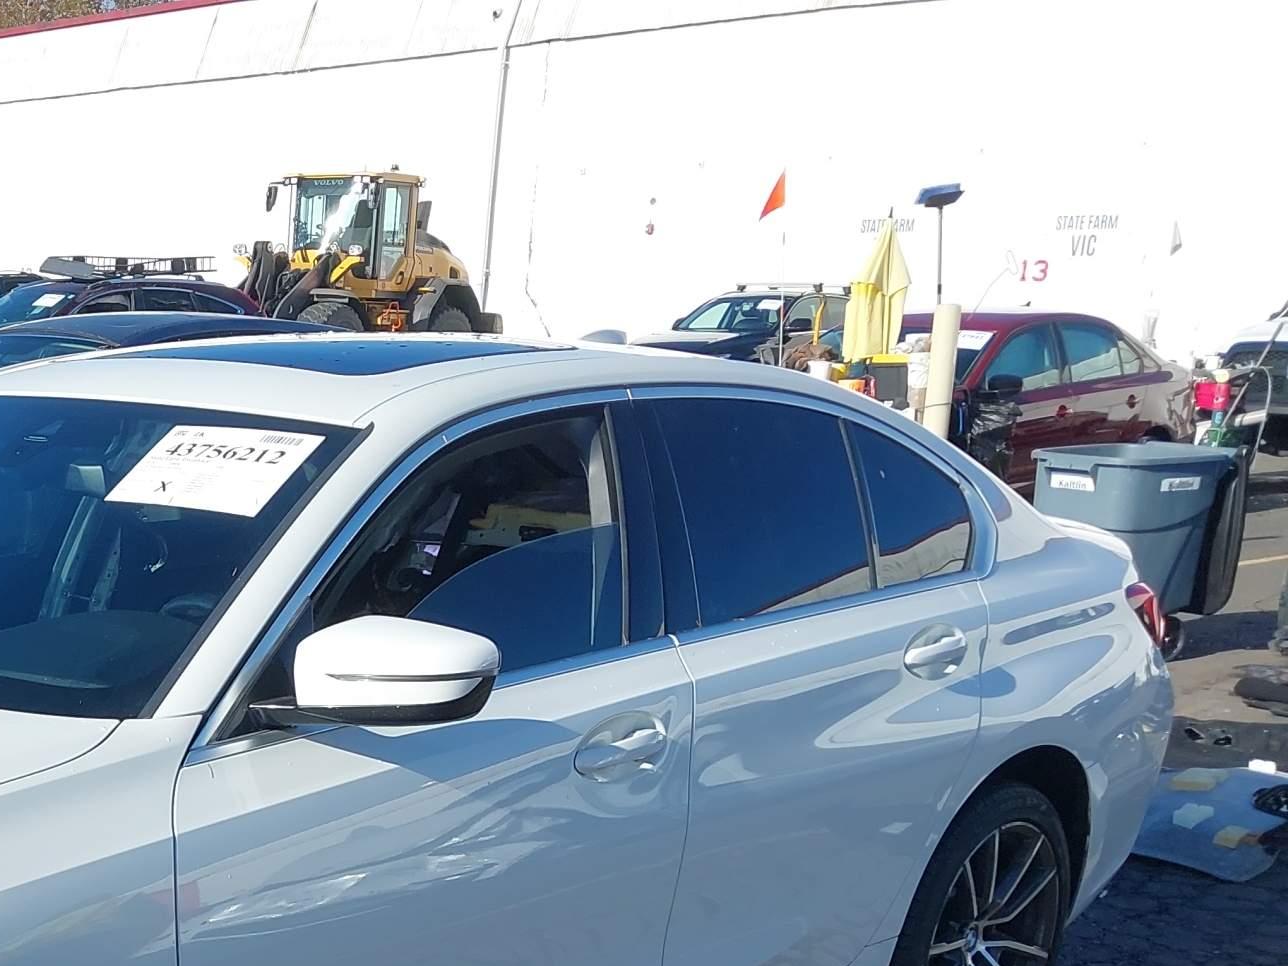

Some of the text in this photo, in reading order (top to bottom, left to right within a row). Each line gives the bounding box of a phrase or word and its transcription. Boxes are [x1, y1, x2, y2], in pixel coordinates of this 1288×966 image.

[1055, 214, 1119, 231] STATE FARM
[1071, 234, 1097, 257] VIC
[1019, 259, 1049, 282] 13
[165, 442, 286, 465] 43756212
